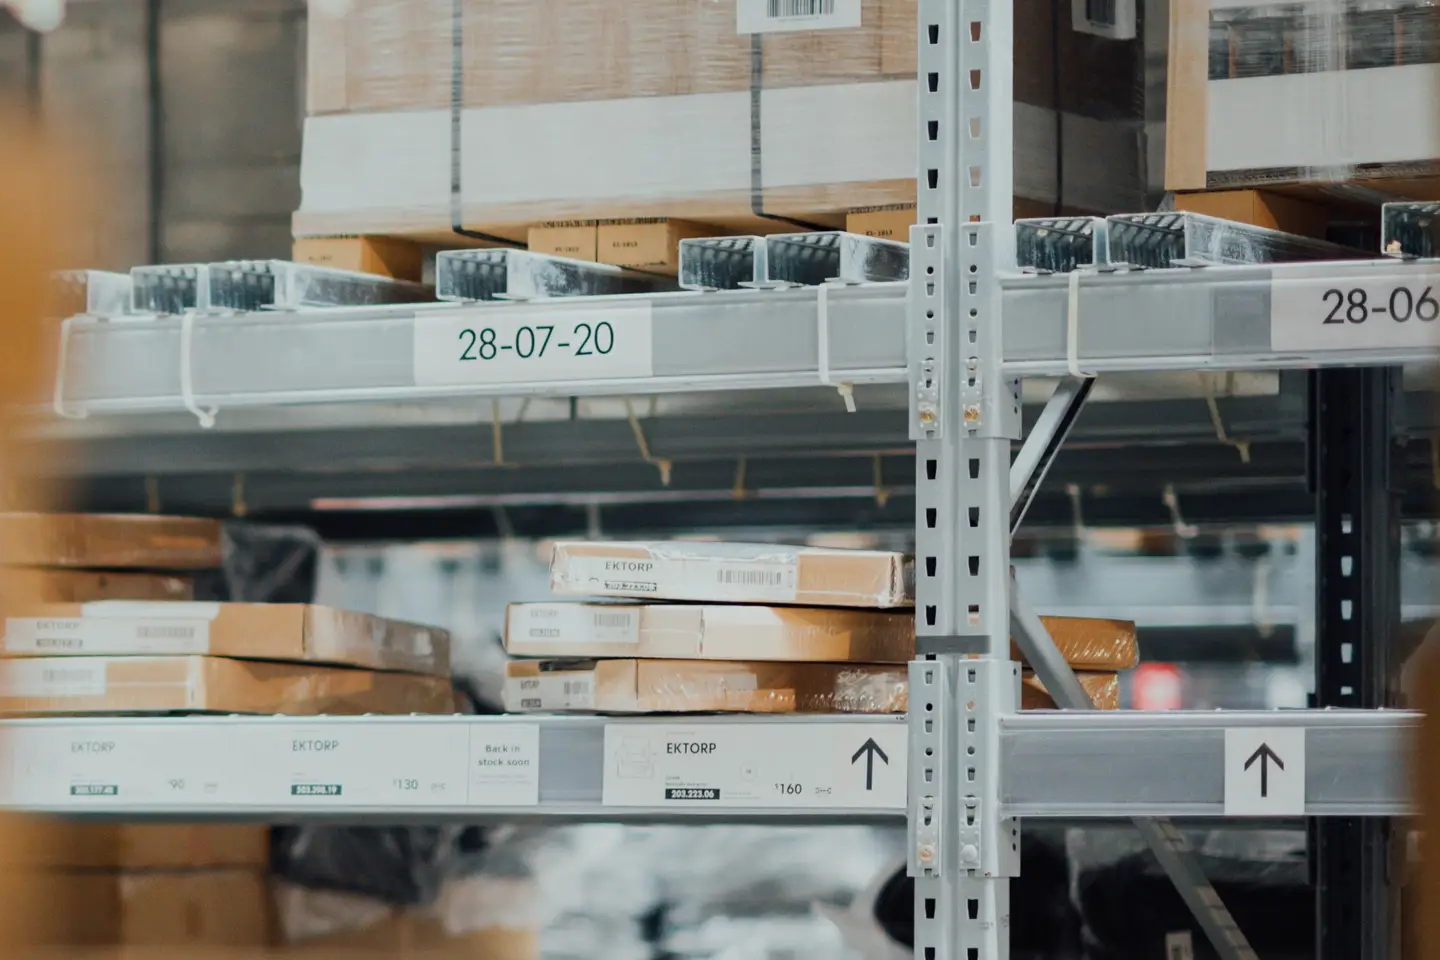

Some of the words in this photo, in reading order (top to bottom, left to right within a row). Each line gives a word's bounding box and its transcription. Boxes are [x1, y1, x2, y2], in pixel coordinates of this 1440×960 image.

[1322, 286, 1440, 325] 28-06
[458, 321, 615, 361] 28-07-20
[605, 561, 653, 572] EKTORP
[70, 741, 116, 753] EKTORP
[292, 740, 340, 751] EKTORP
[485, 744, 508, 752] Back
[666, 742, 717, 754] EKTORP
[478, 758, 503, 766] stock
[671, 789, 715, 799] 203.223.06
